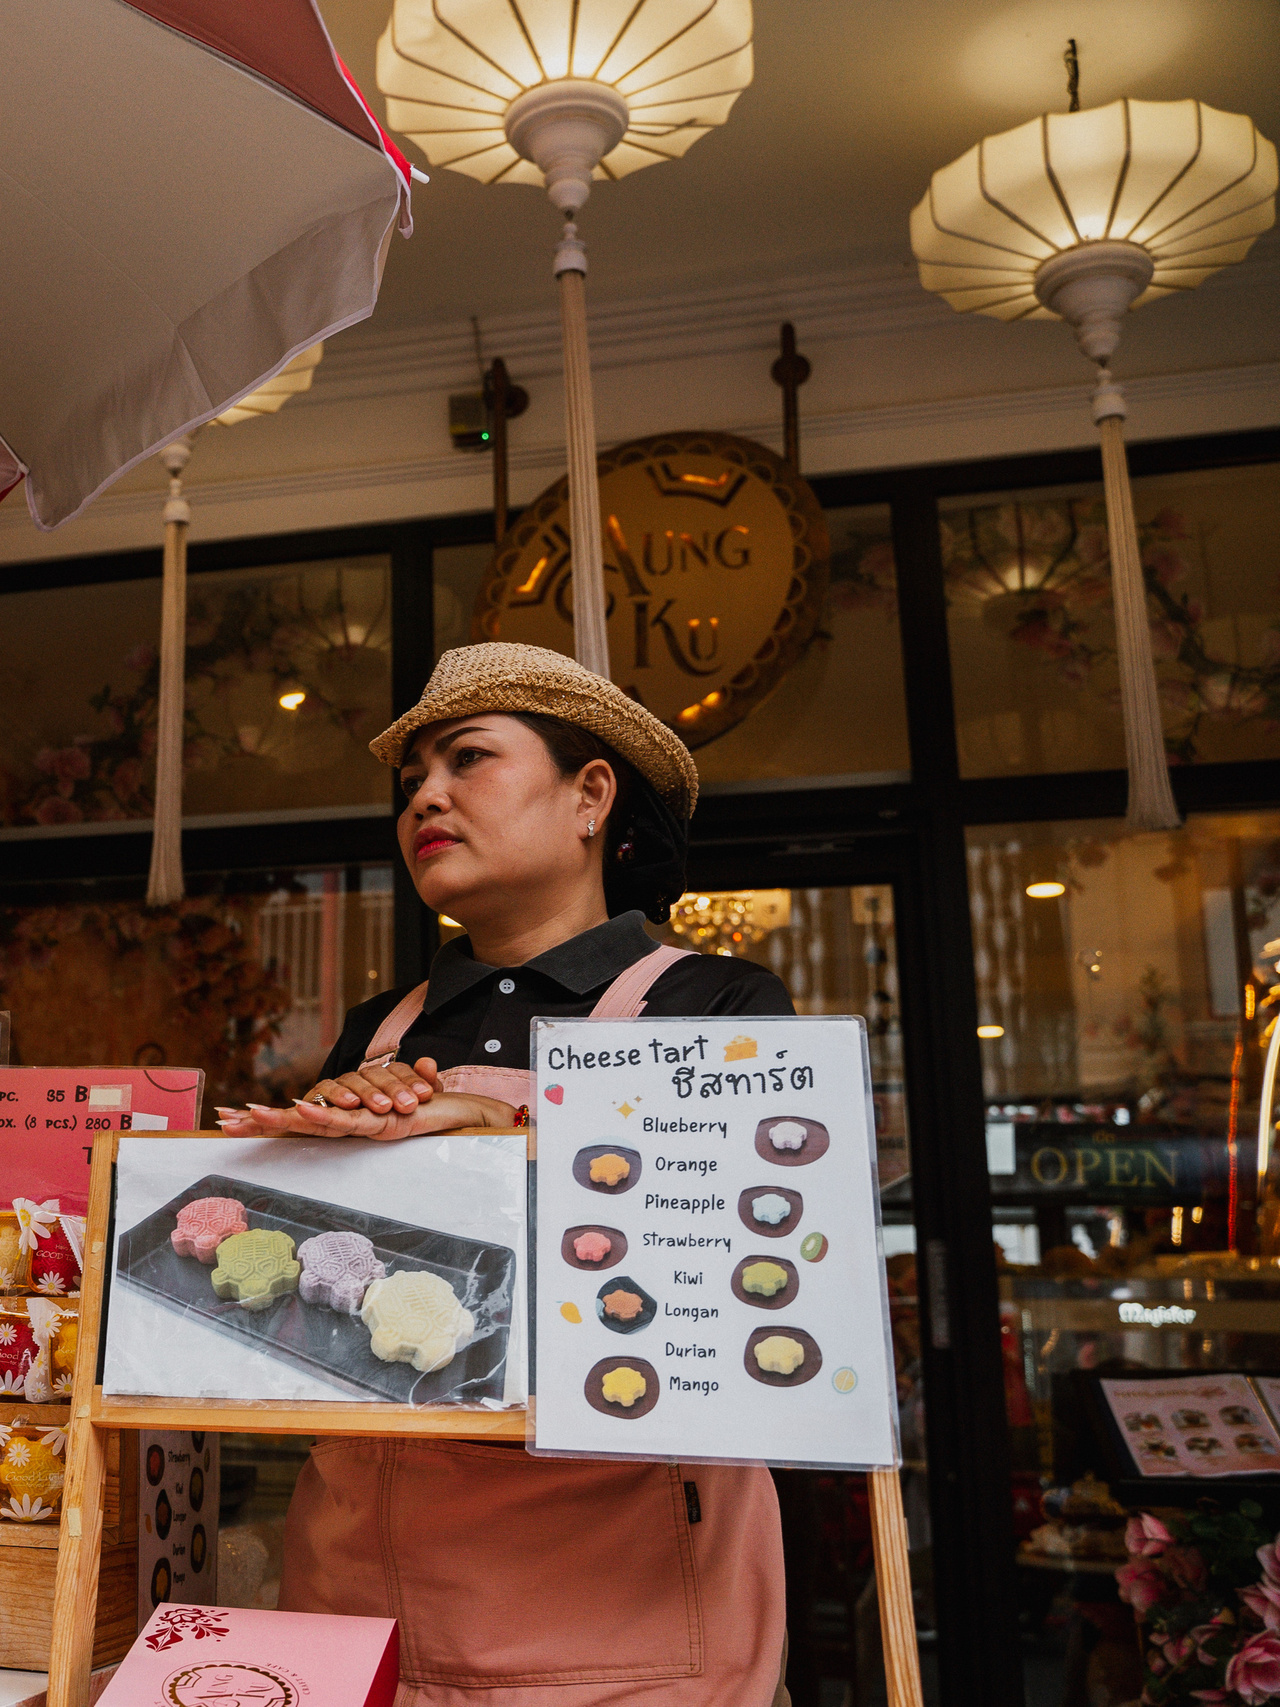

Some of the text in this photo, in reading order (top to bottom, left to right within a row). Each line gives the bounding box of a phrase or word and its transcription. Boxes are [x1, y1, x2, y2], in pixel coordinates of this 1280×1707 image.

[548, 1035, 709, 1070] Cheese tart
[672, 1050, 814, 1098] ชีสทาร์ต
[46, 1089, 65, 1102] 35
[25, 1114, 37, 1130] (8
[85, 1118, 111, 1130] 280
[642, 1117, 727, 1139] Blueberry
[655, 1156, 718, 1176] Orange
[1030, 1146, 1179, 1187] OPEN
[644, 1194, 726, 1214] Pineapple
[642, 1231, 731, 1253] Strawberry
[674, 1270, 703, 1285] Kiwi
[665, 1302, 719, 1322] Longan
[665, 1341, 716, 1358] Durian
[669, 1376, 719, 1396] Mango
[6, 1471, 35, 1482] Good
